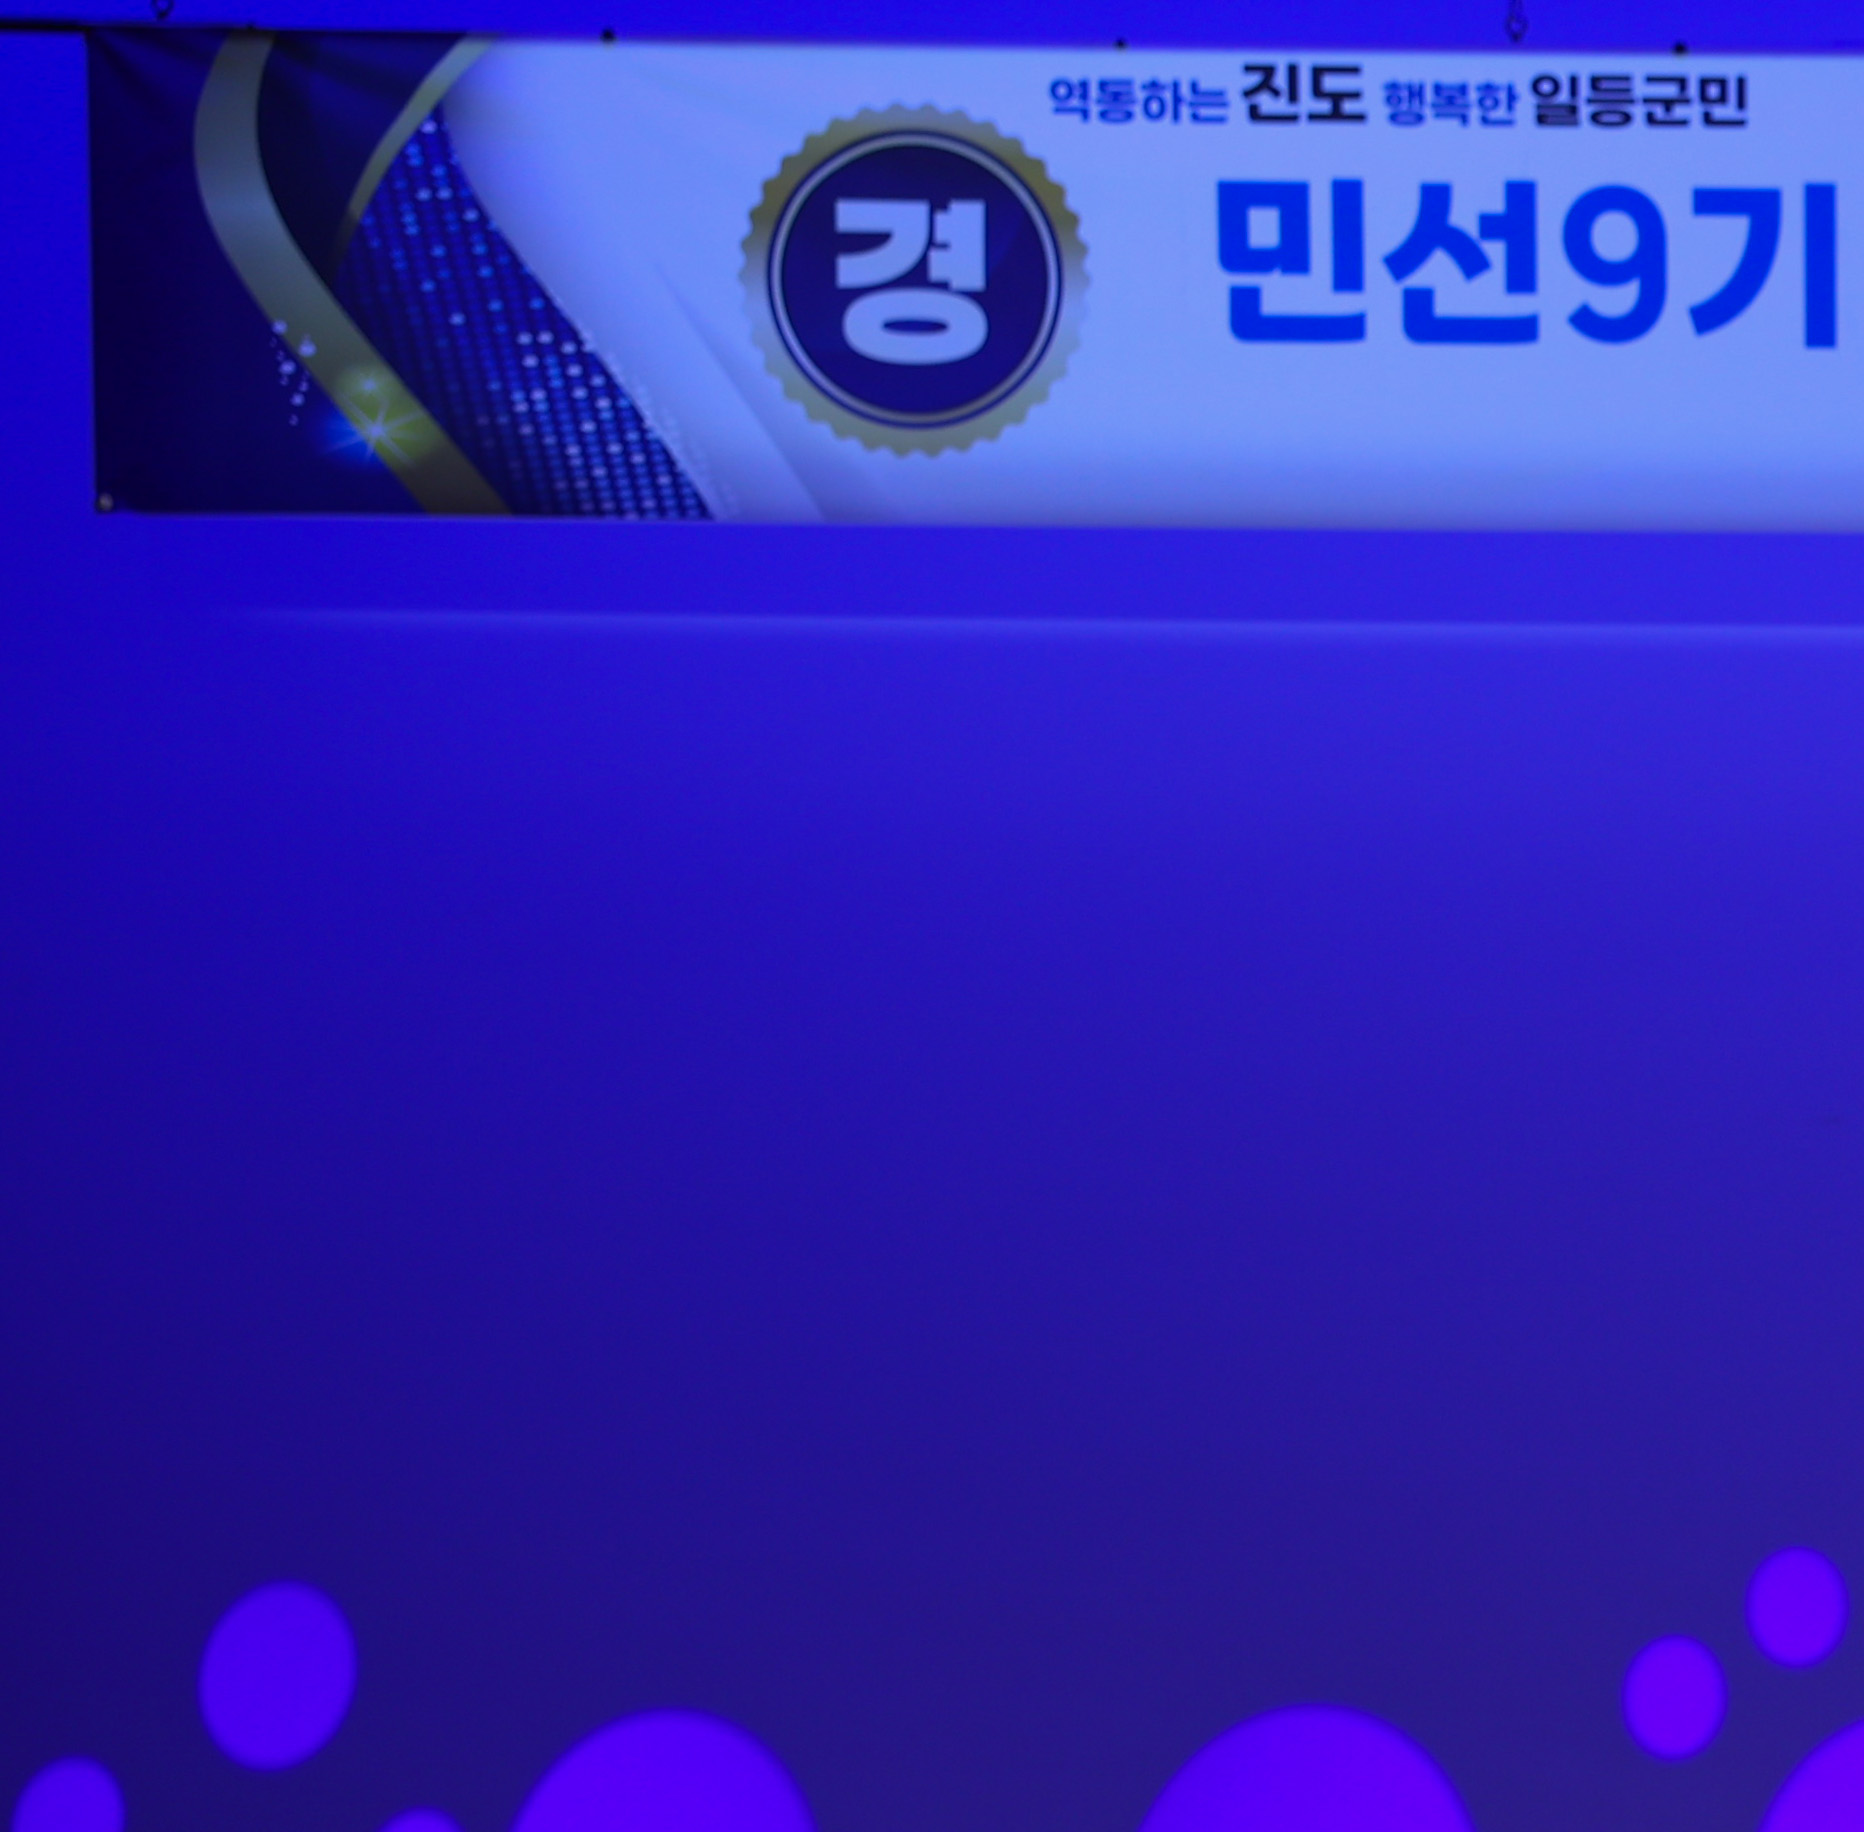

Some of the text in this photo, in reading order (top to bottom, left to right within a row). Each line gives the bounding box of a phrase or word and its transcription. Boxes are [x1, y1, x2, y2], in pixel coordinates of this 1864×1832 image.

[1048, 61, 1748, 128] 역동하는 진도 행복한 일등군민
[835, 199, 987, 364] 경
[1216, 177, 1838, 350] 민선9기
